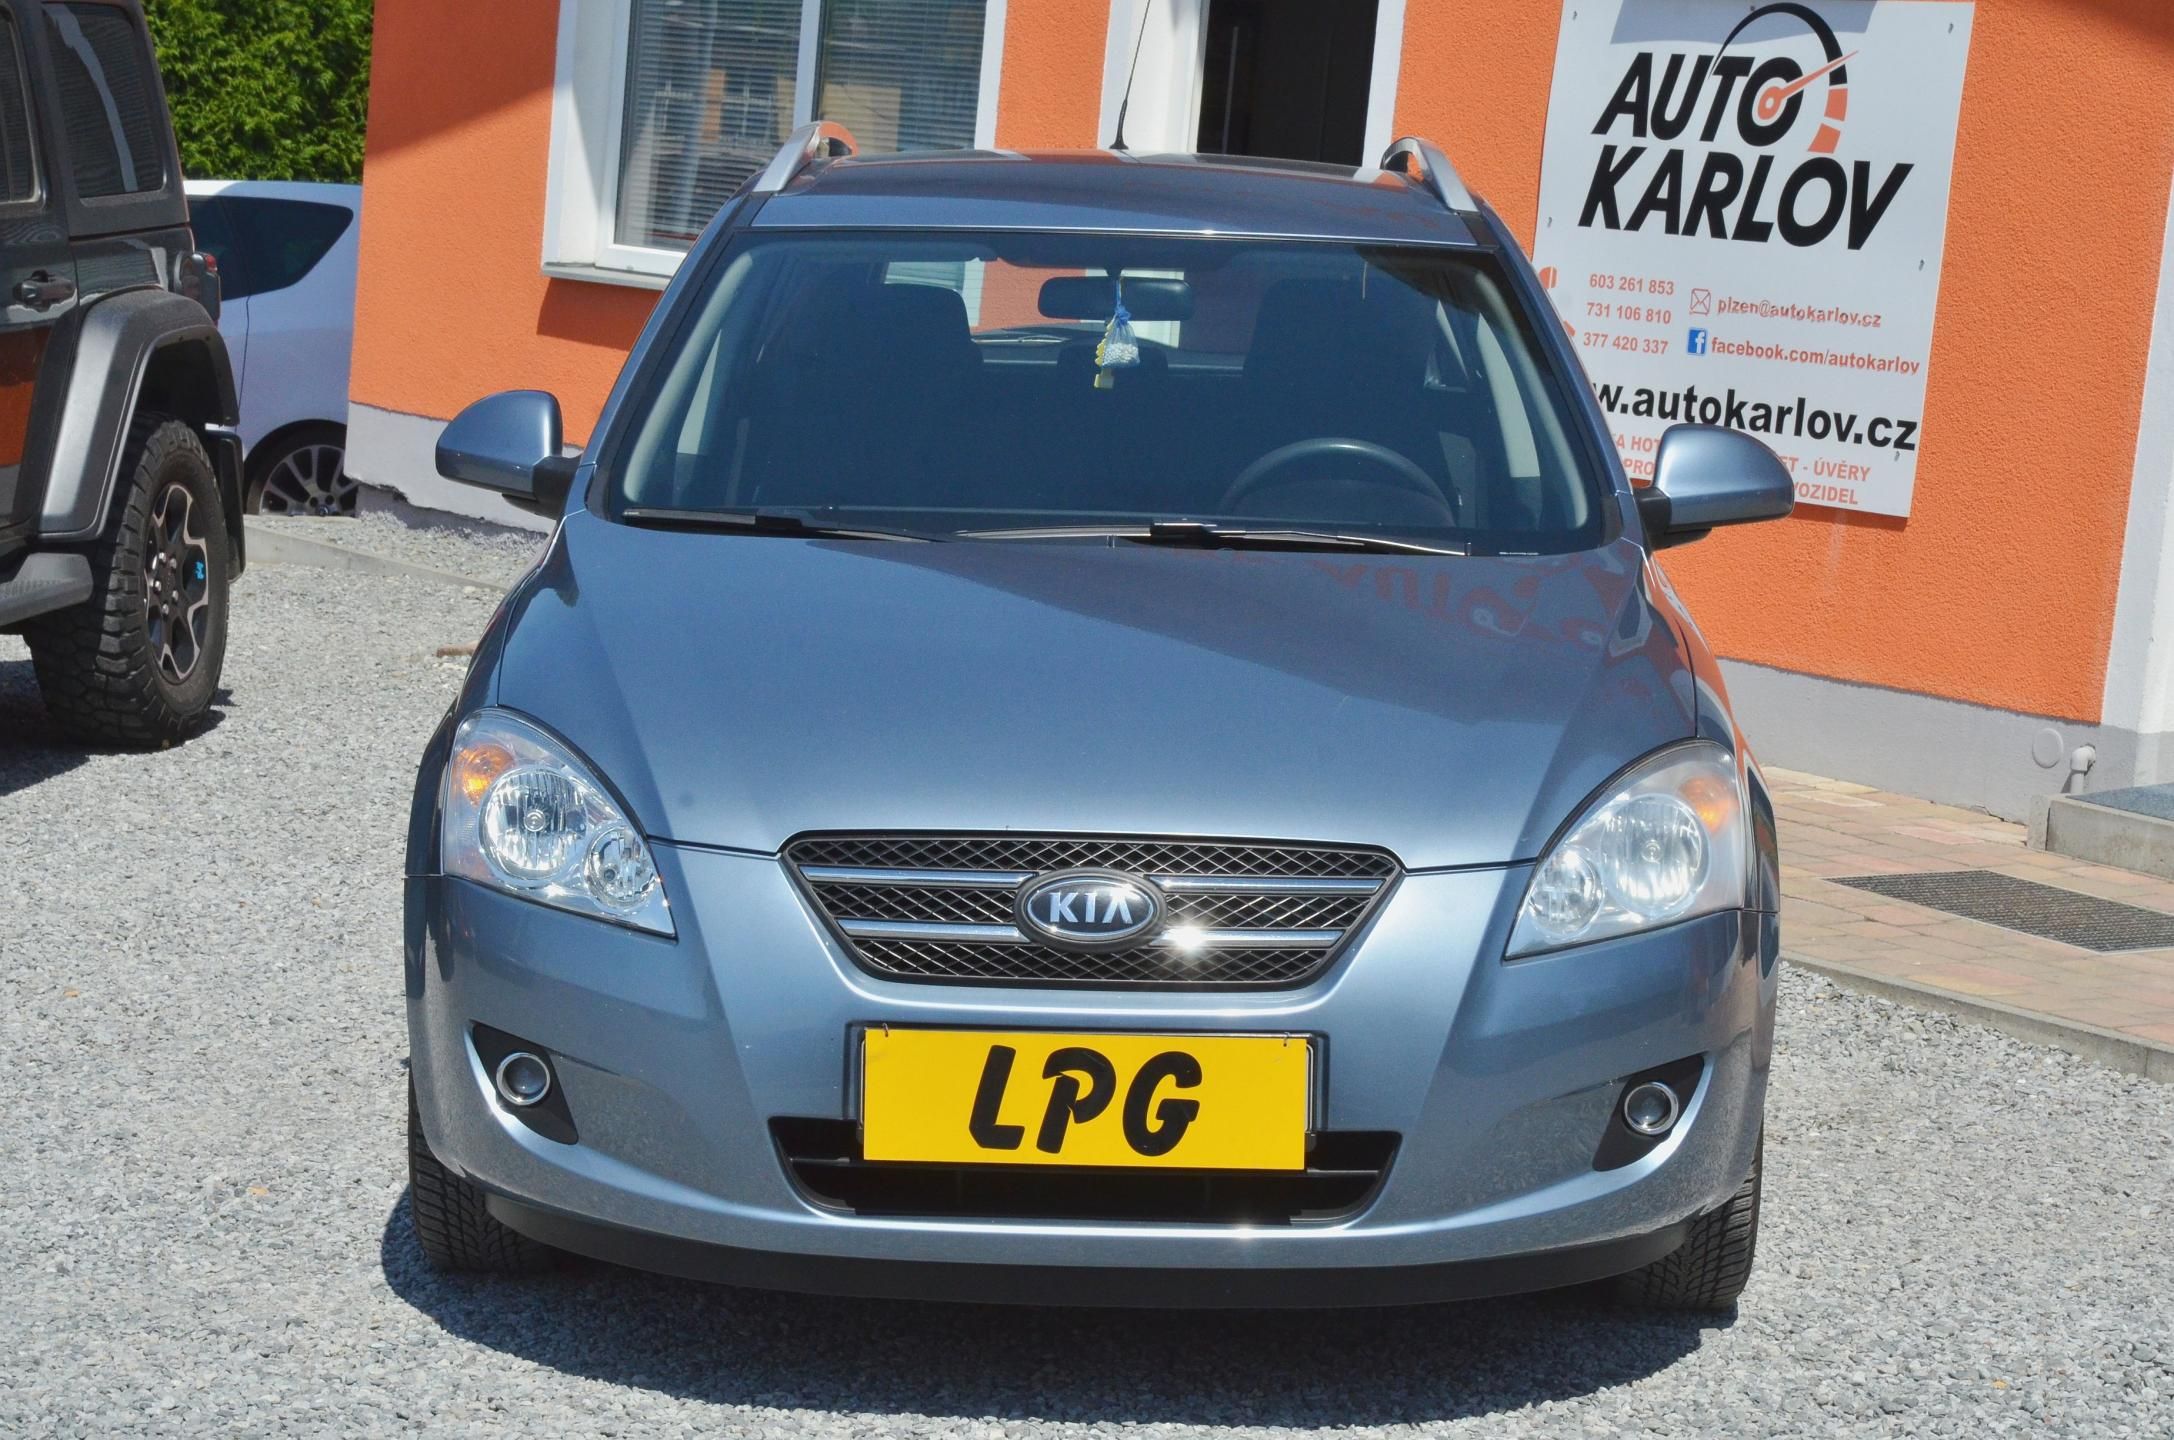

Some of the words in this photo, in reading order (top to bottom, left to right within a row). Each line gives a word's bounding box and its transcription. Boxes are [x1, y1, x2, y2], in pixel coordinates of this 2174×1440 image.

[1591, 52, 1804, 147] AUTO
[1578, 144, 1914, 250] KARLOV
[1589, 273, 1615, 290] 603
[1618, 276, 1644, 293] 261
[1648, 279, 1675, 296] 853
[1586, 301, 1611, 318] 731
[1616, 305, 1641, 321] 106
[1645, 308, 1672, 324] 810
[1716, 296, 1882, 328] plzen@autokarlov.cz
[1583, 331, 1609, 348] 377
[1612, 335, 1638, 352] 420
[1642, 338, 1669, 355] 337
[1711, 336, 1920, 376] facebook.com/autokarlov
[1813, 457, 1871, 482] ÚVĚRY
[1048, 890, 1134, 924] KIA
[968, 1044, 1203, 1157] LPG
